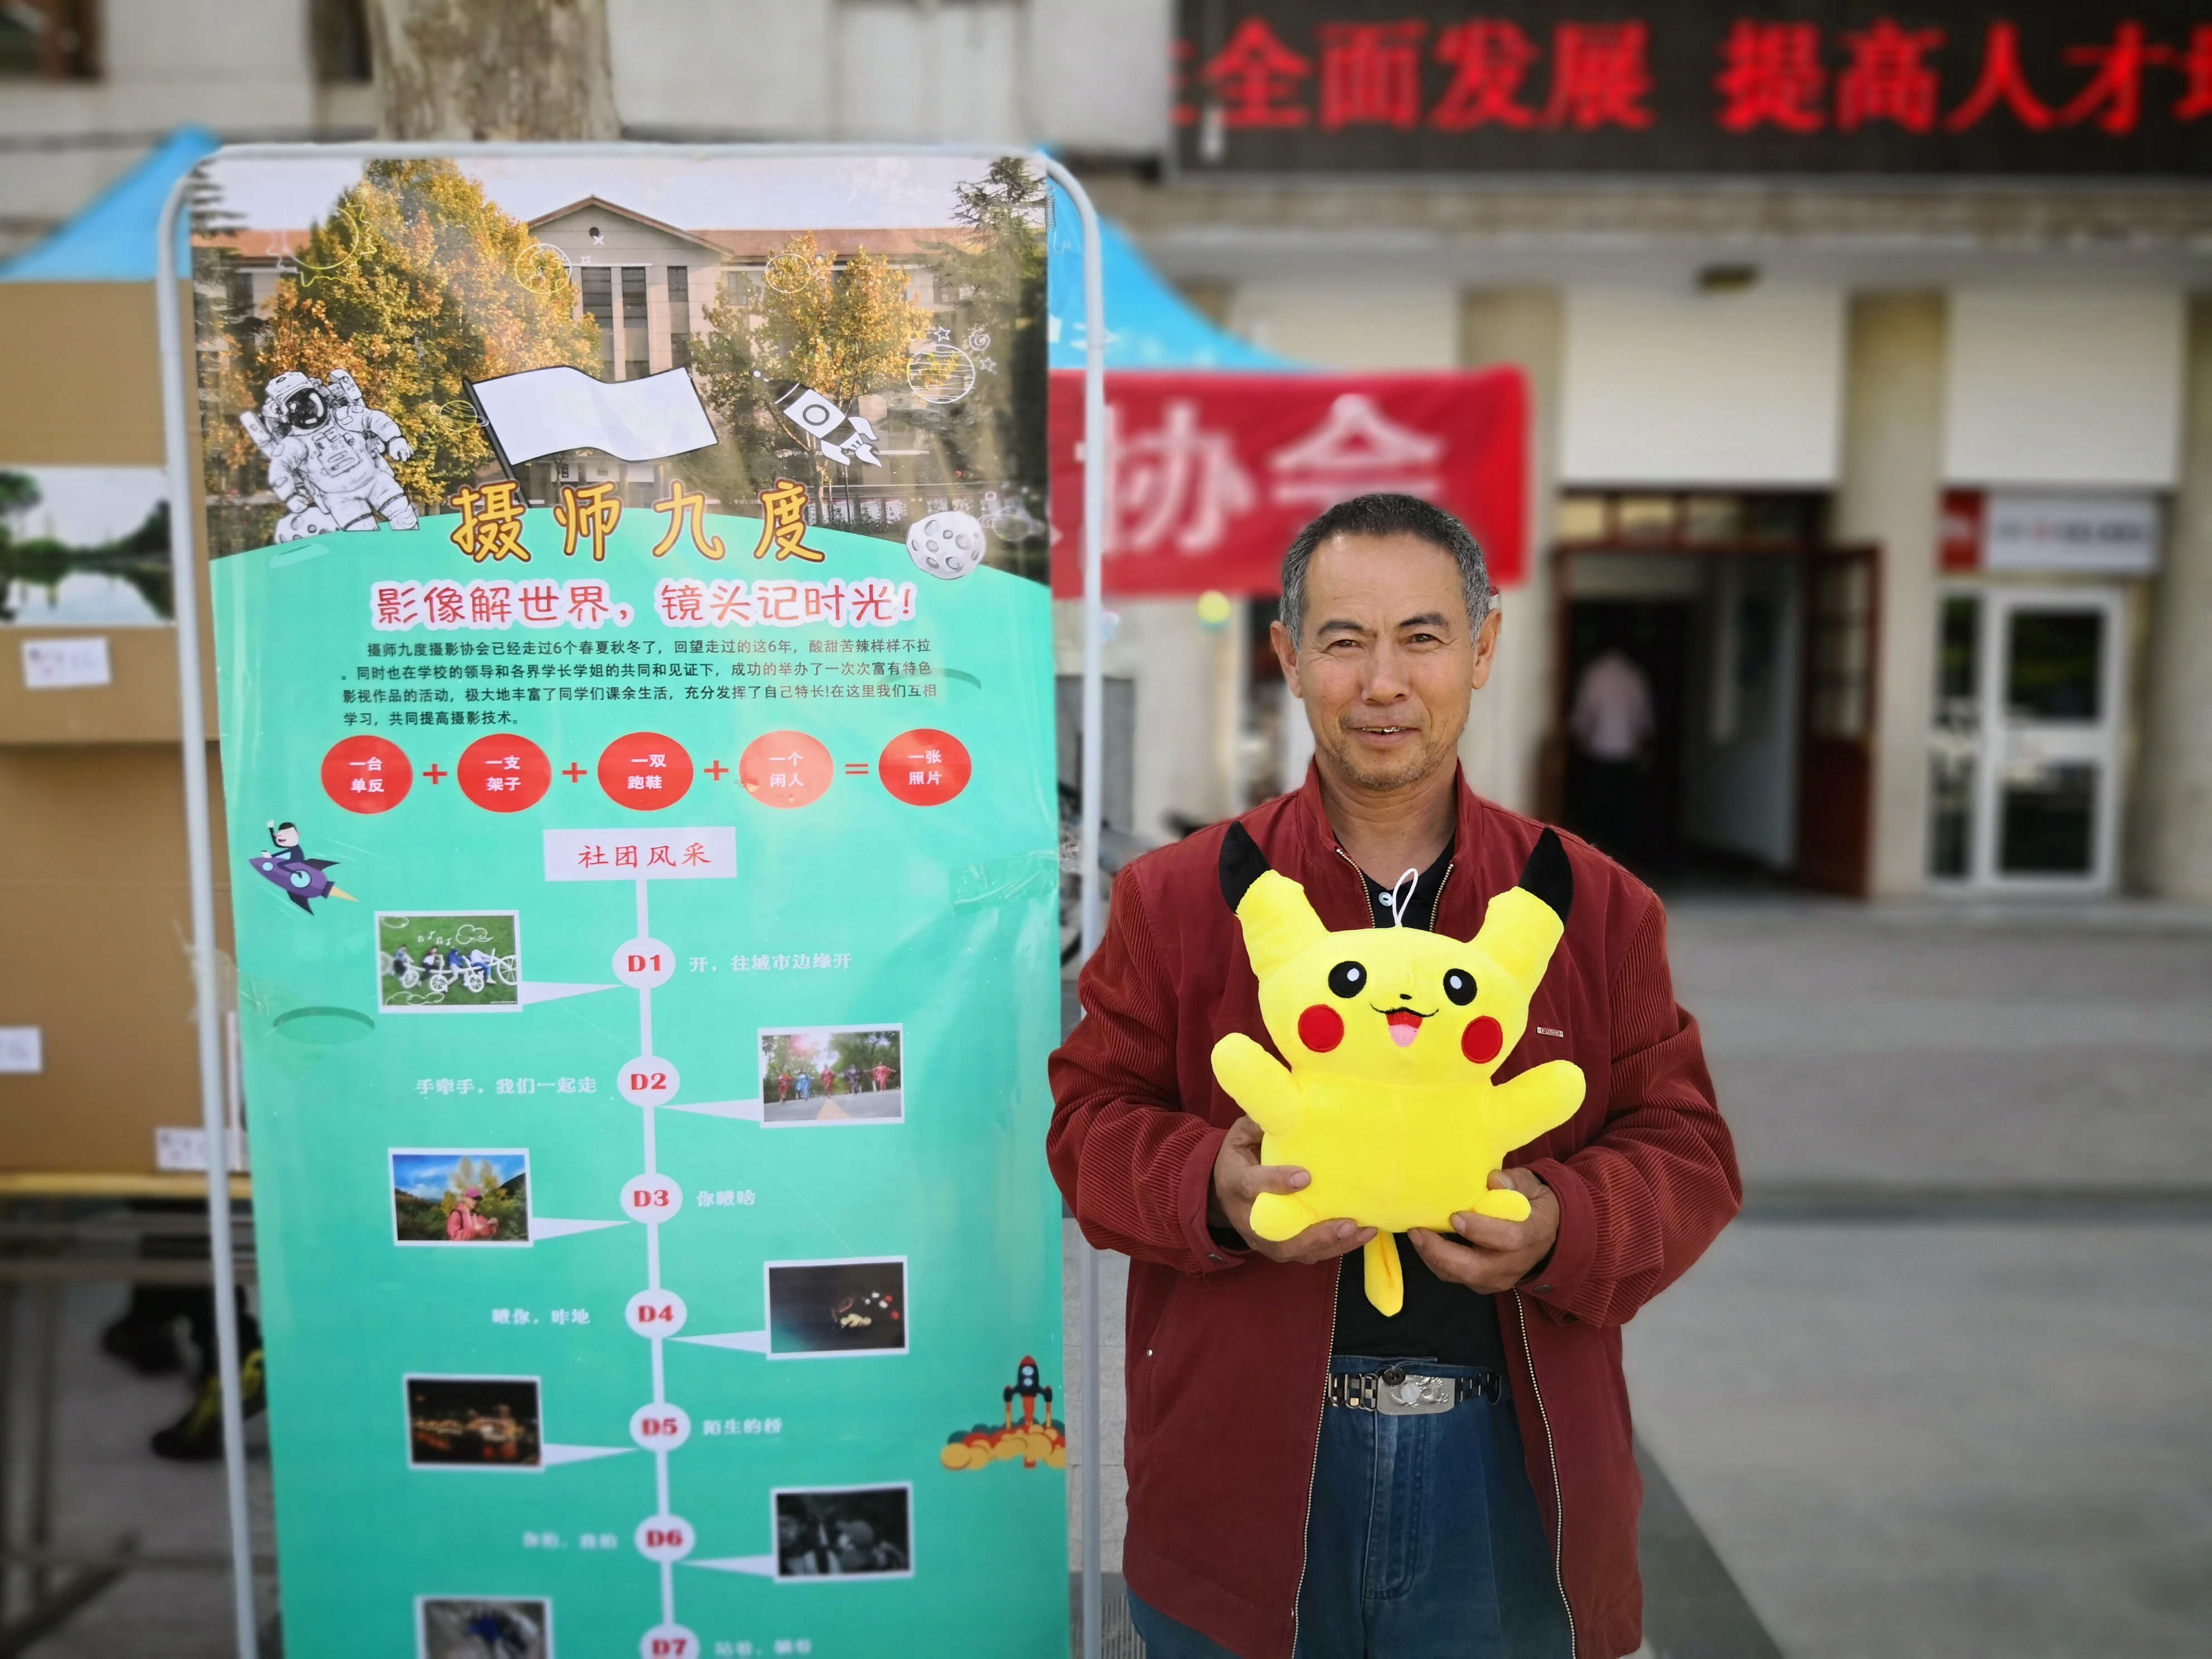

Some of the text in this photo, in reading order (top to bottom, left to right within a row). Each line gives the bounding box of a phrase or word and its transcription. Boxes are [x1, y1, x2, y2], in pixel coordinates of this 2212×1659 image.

[1170, 17, 1657, 134] 全面发展
[450, 480, 825, 562] 摄师九度
[377, 583, 911, 624] 影像解世界，镜头记时光!
[343, 710, 518, 726] 学习，共同提高摄影技术。
[349, 756, 382, 772] 一台
[486, 755, 521, 770] 一支
[631, 754, 667, 768] 一双
[769, 751, 804, 767] 一个
[908, 749, 942, 764] 一张
[351, 778, 385, 793] 单反
[487, 777, 521, 792] 架子
[627, 774, 663, 790] 跑鞋
[770, 773, 804, 788] 闲人
[909, 770, 942, 785] 照片
[578, 842, 712, 869] 社团风采
[627, 954, 662, 973] D1
[630, 1073, 668, 1092] D2
[633, 1189, 671, 1209] D3
[638, 1304, 674, 1323] D4
[642, 1418, 678, 1437] D5
[647, 1530, 683, 1547] D6
[652, 1639, 687, 1656] D7
